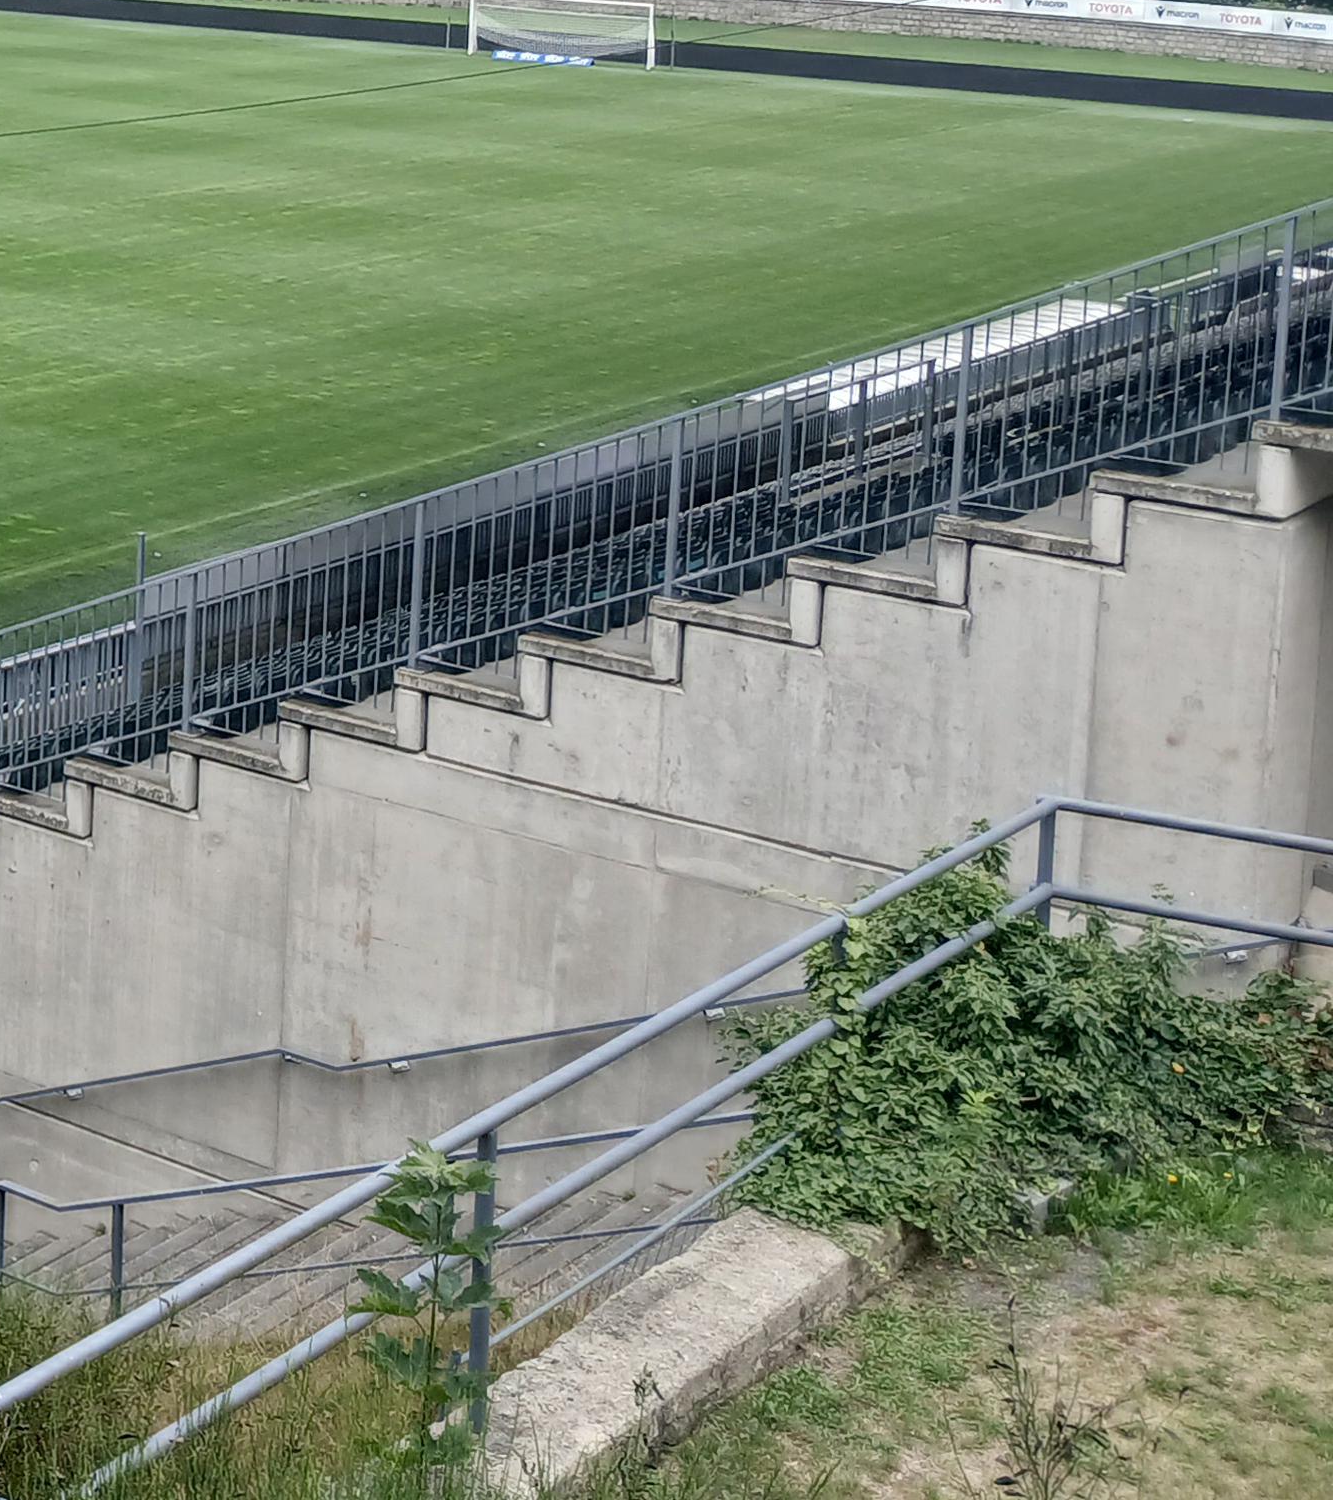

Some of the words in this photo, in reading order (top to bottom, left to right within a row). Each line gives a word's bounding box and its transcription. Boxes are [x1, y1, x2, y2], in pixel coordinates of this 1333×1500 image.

[1034, 0, 1069, 9] macron
[1088, 2, 1133, 16] TOYOTA
[1165, 9, 1200, 20] macron
[1219, 12, 1263, 26] TOYOTA
[1293, 20, 1327, 31] macron
